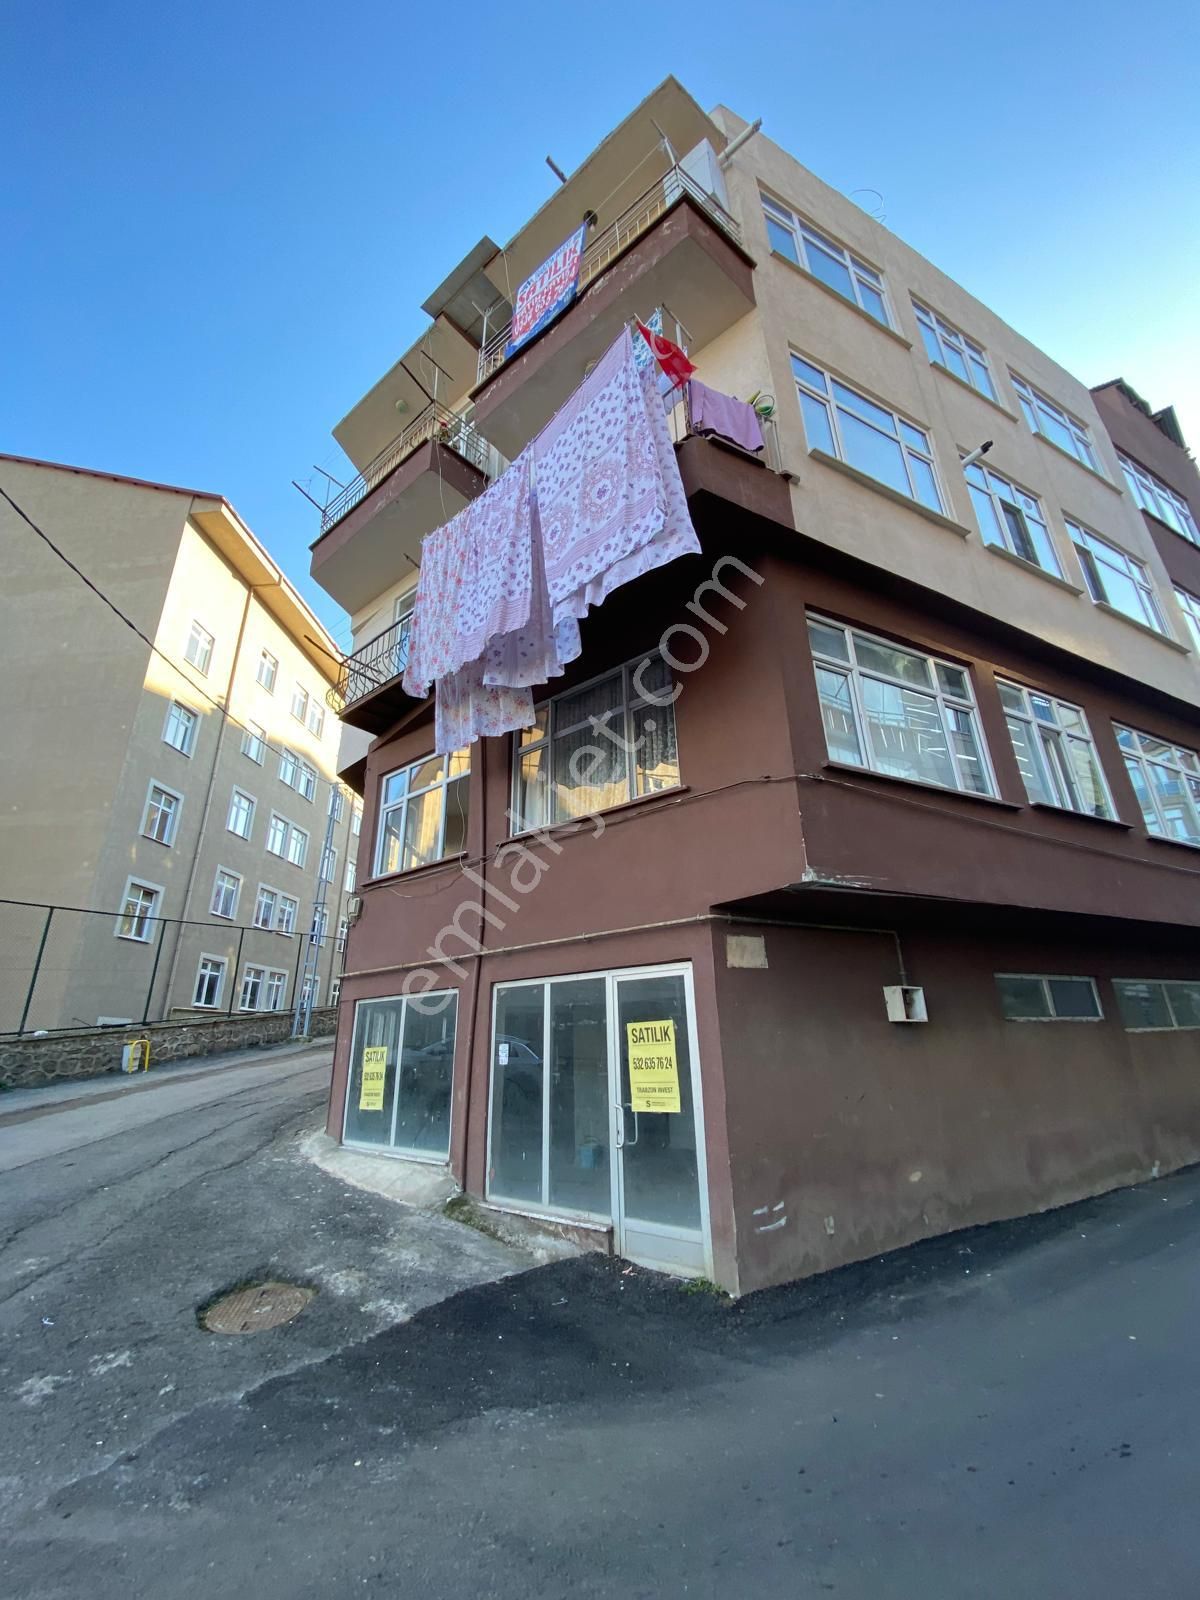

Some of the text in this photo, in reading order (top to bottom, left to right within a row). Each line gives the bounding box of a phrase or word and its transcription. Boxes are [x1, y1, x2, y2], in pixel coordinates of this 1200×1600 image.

[518, 241, 577, 307] SATILIK
[632, 1026, 671, 1043] SATILIK
[365, 1051, 385, 1062] SATILIK
[633, 1057, 672, 1070] 532 635 76 24
